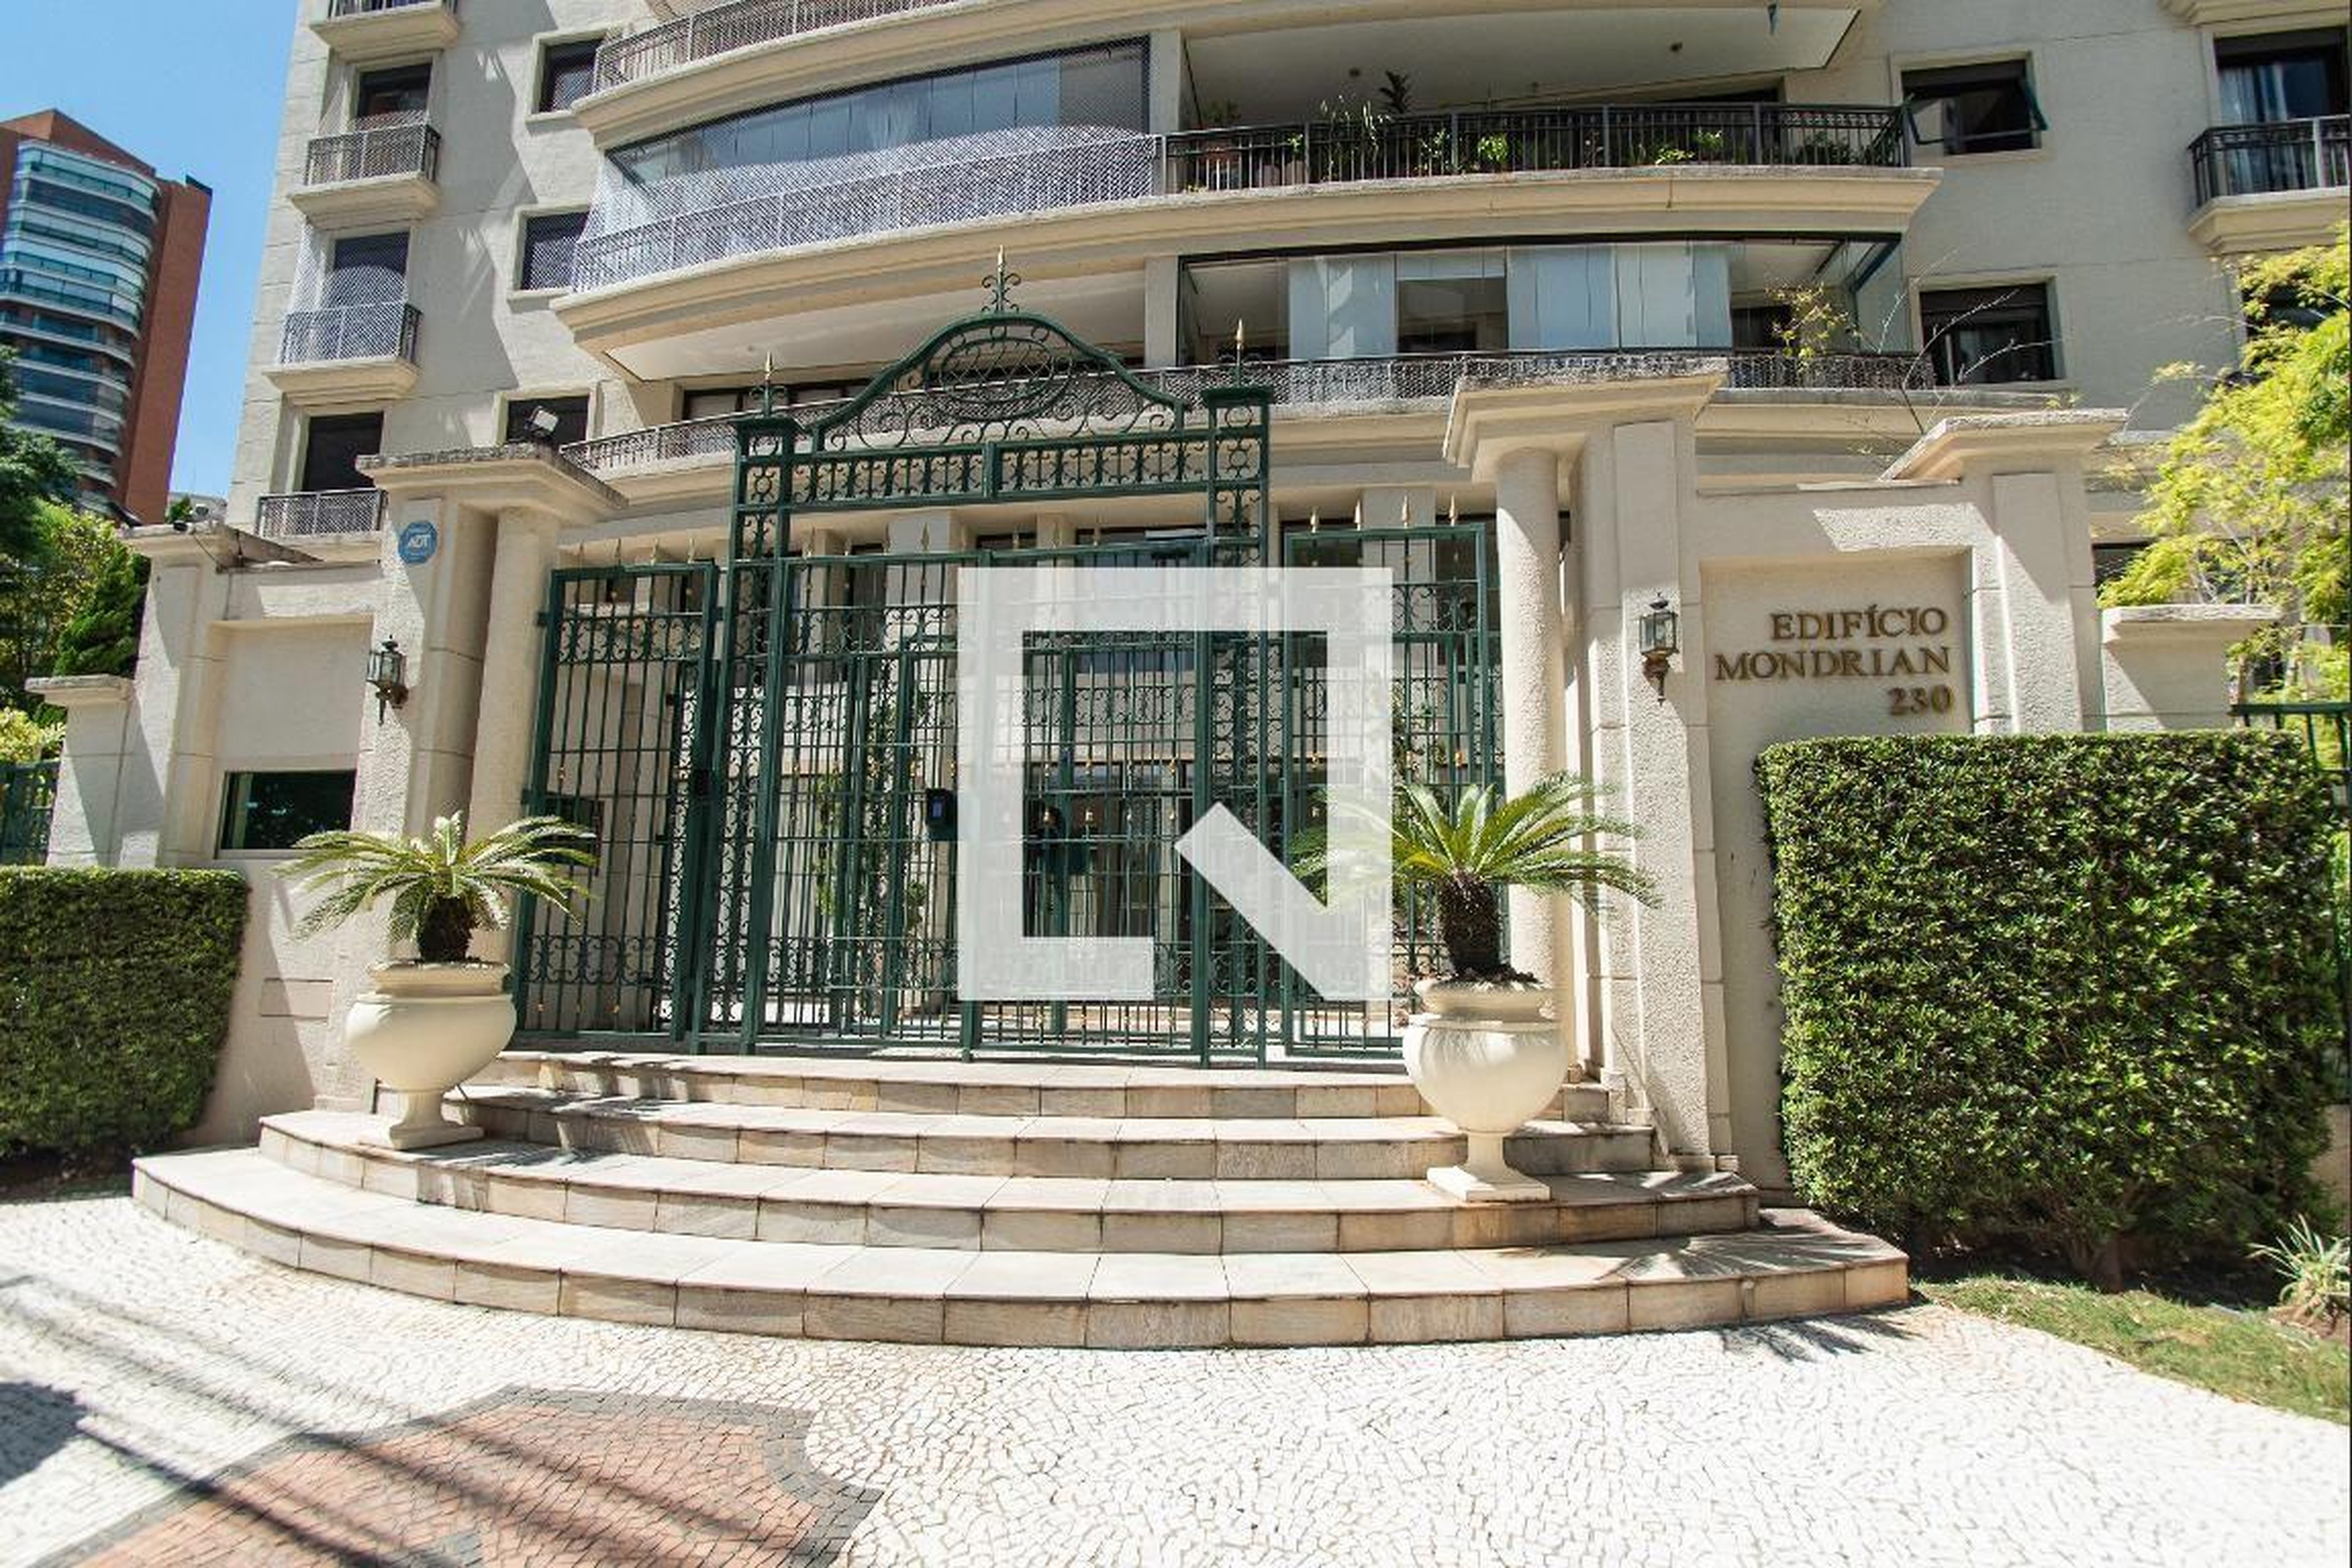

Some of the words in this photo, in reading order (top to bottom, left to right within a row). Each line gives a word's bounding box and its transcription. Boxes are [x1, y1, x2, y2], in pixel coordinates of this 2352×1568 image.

[1771, 604, 1948, 640] EDIFÍCIO
[1715, 646, 1950, 680] MONDRIAN
[1888, 684, 1953, 715] 230
